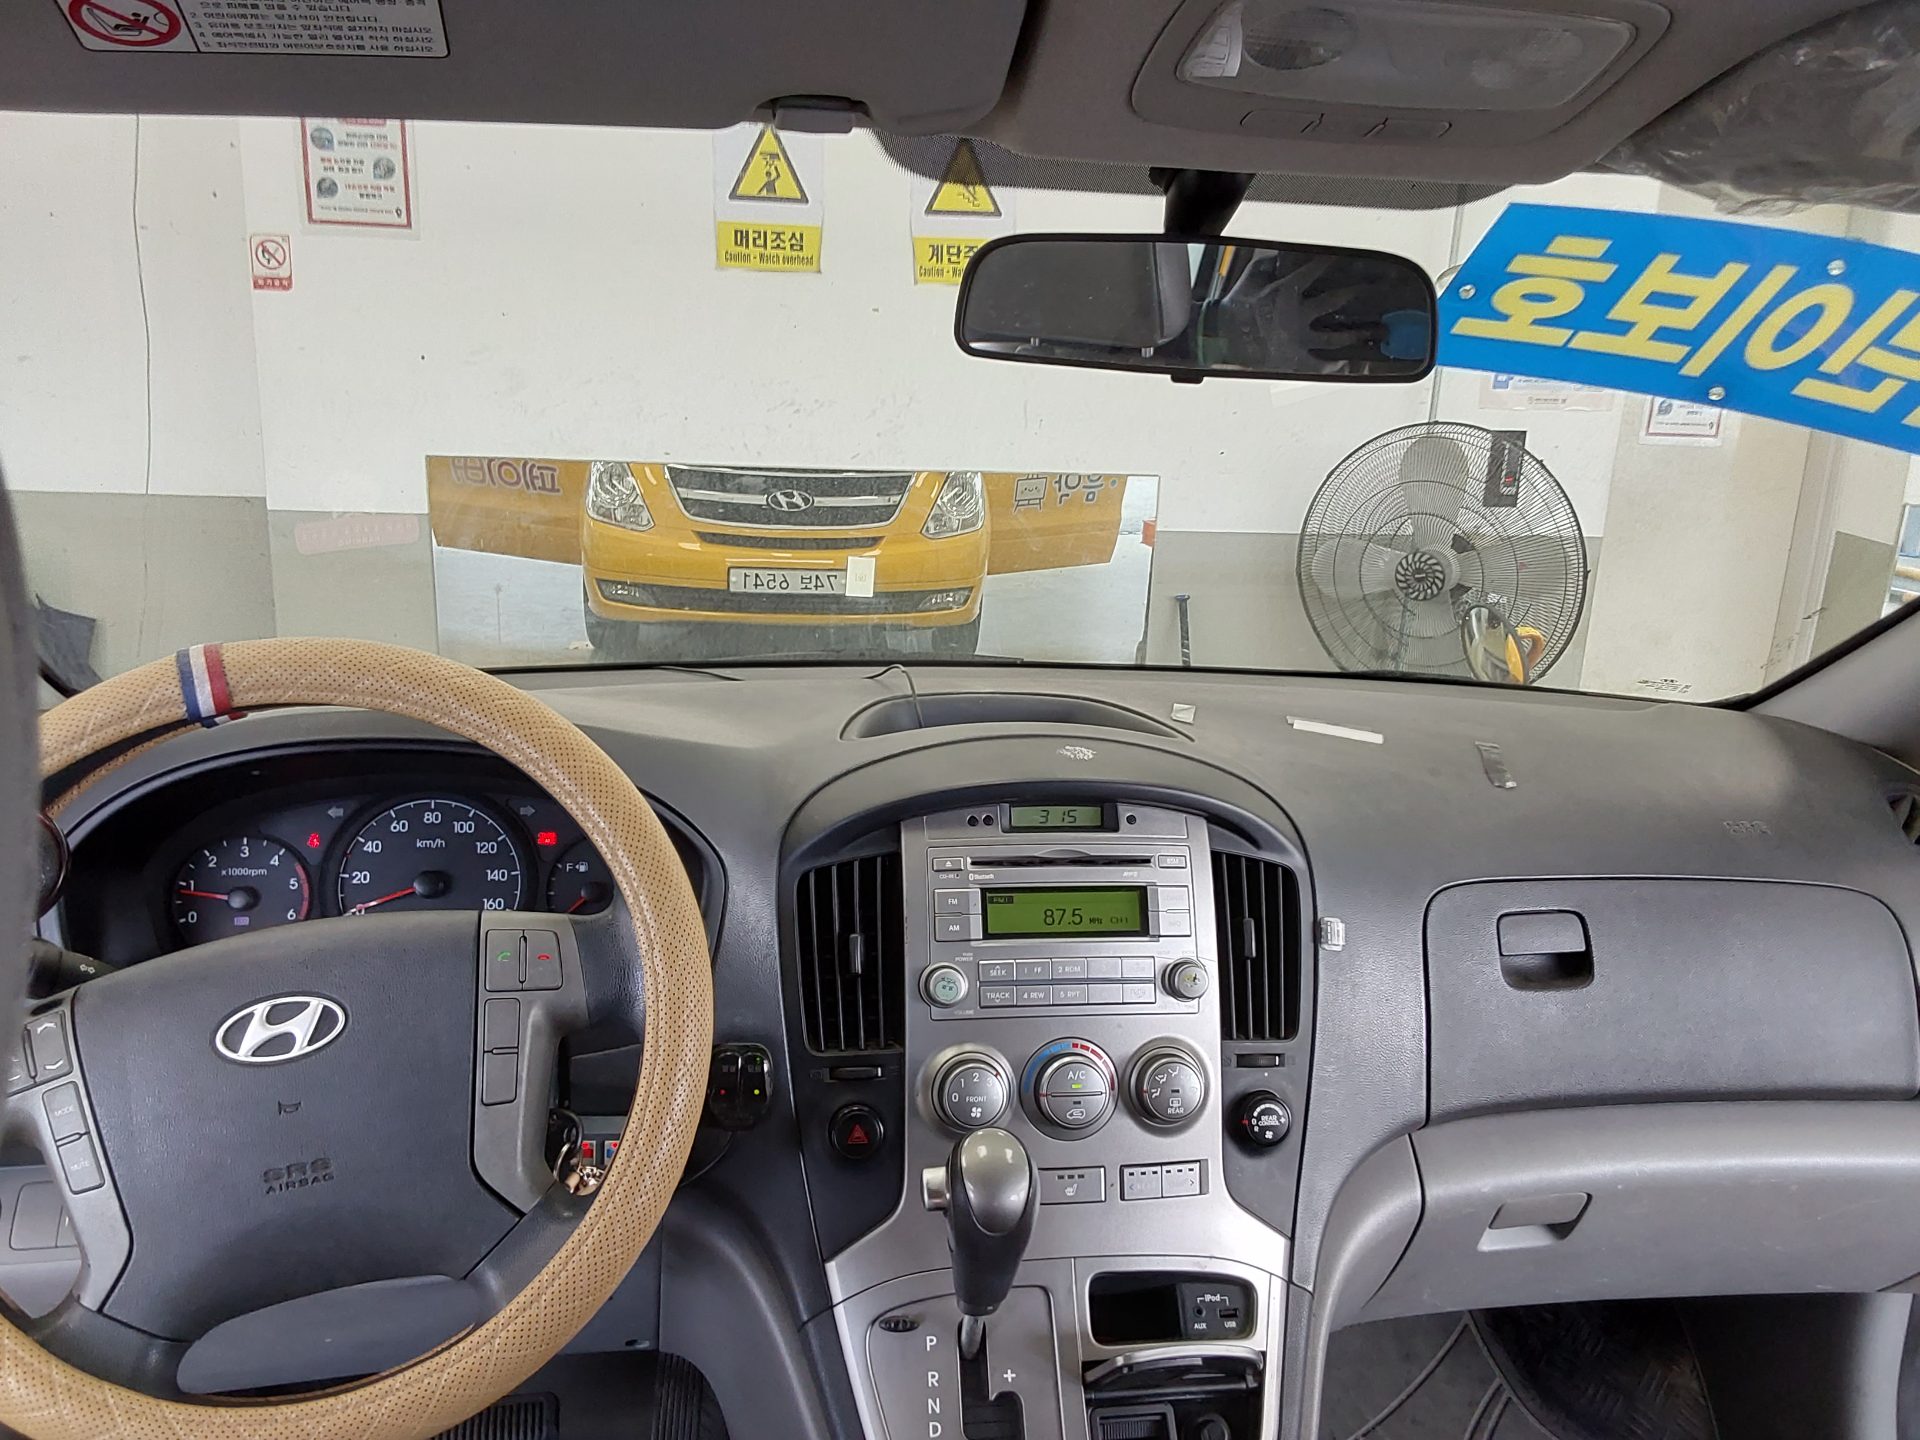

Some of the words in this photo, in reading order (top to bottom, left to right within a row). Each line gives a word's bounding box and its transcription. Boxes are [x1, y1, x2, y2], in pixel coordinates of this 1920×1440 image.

[733, 229, 804, 252] 머리조심
[724, 250, 751, 264] Caution
[758, 251, 780, 266] Watch
[781, 254, 814, 267] overhead
[919, 266, 944, 278] Caution
[423, 812, 441, 824] 80
[390, 820, 408, 833] 60
[453, 821, 475, 834] 100
[363, 840, 382, 853] 40
[416, 838, 446, 849] km/h
[475, 842, 497, 854] 120
[239, 846, 249, 858] 3
[208, 856, 217, 867] 2
[269, 855, 279, 866] 4
[566, 863, 574, 873] F
[352, 871, 370, 884] 20
[486, 869, 508, 881] 140
[189, 880, 195, 891] 1
[289, 878, 299, 889] 5
[482, 898, 504, 910] 160
[188, 911, 197, 923] 0
[287, 908, 297, 920] 6
[1043, 908, 1083, 926] 87.5
[990, 969, 1007, 977] SEEK
[1065, 965, 1081, 973] RDM
[1030, 991, 1045, 999] REW
[972, 1072, 980, 1082] 2
[1067, 1070, 1086, 1081] A/C
[960, 1078, 965, 1088] 1
[986, 1077, 993, 1087] 3
[951, 1092, 959, 1102] 0
[965, 1095, 987, 1103] FRONT
[1167, 1107, 1184, 1115] REAR
[263, 1157, 332, 1183] SRS
[265, 1172, 335, 1195] AIRBAG
[1193, 1322, 1208, 1330] AUX
[1224, 1321, 1237, 1329] USB
[926, 1335, 937, 1352] P
[927, 1371, 939, 1387] R
[927, 1397, 940, 1414] N
[929, 1422, 942, 1438] D
